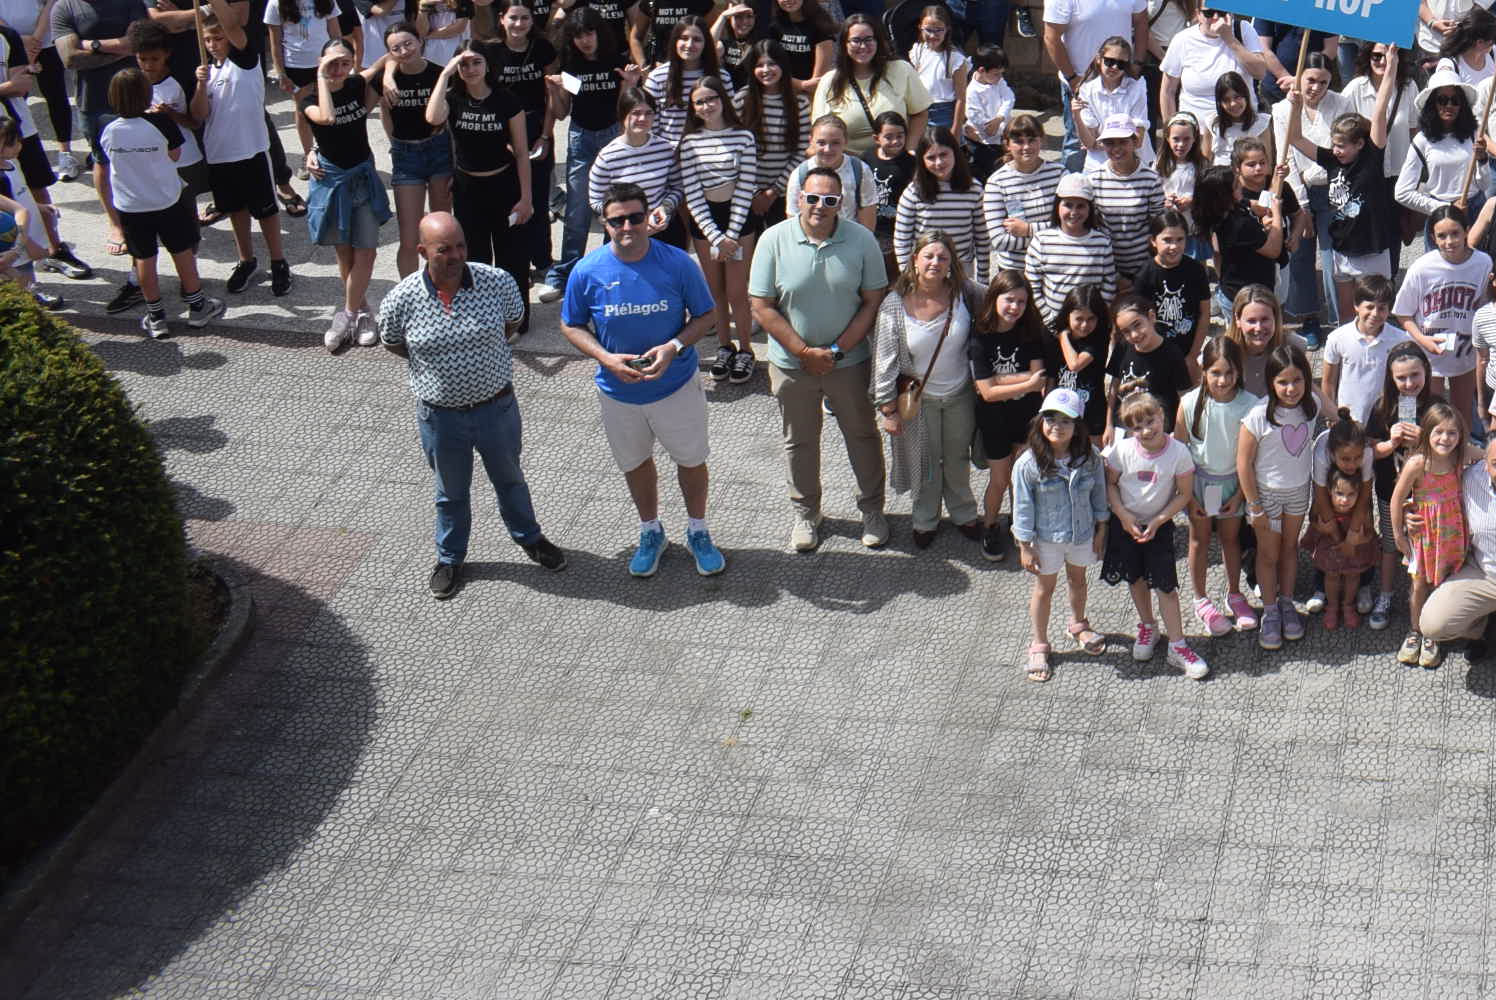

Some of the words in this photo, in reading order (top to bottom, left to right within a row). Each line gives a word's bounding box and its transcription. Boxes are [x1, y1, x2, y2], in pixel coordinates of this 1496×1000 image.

[503, 65, 520, 74] NOT
[521, 63, 535, 73] MY
[596, 72, 609, 80] MY
[580, 81, 616, 90] ROBLEM
[461, 112, 480, 121] NOT
[482, 113, 496, 123] MY
[455, 121, 503, 132] PROBLEM
